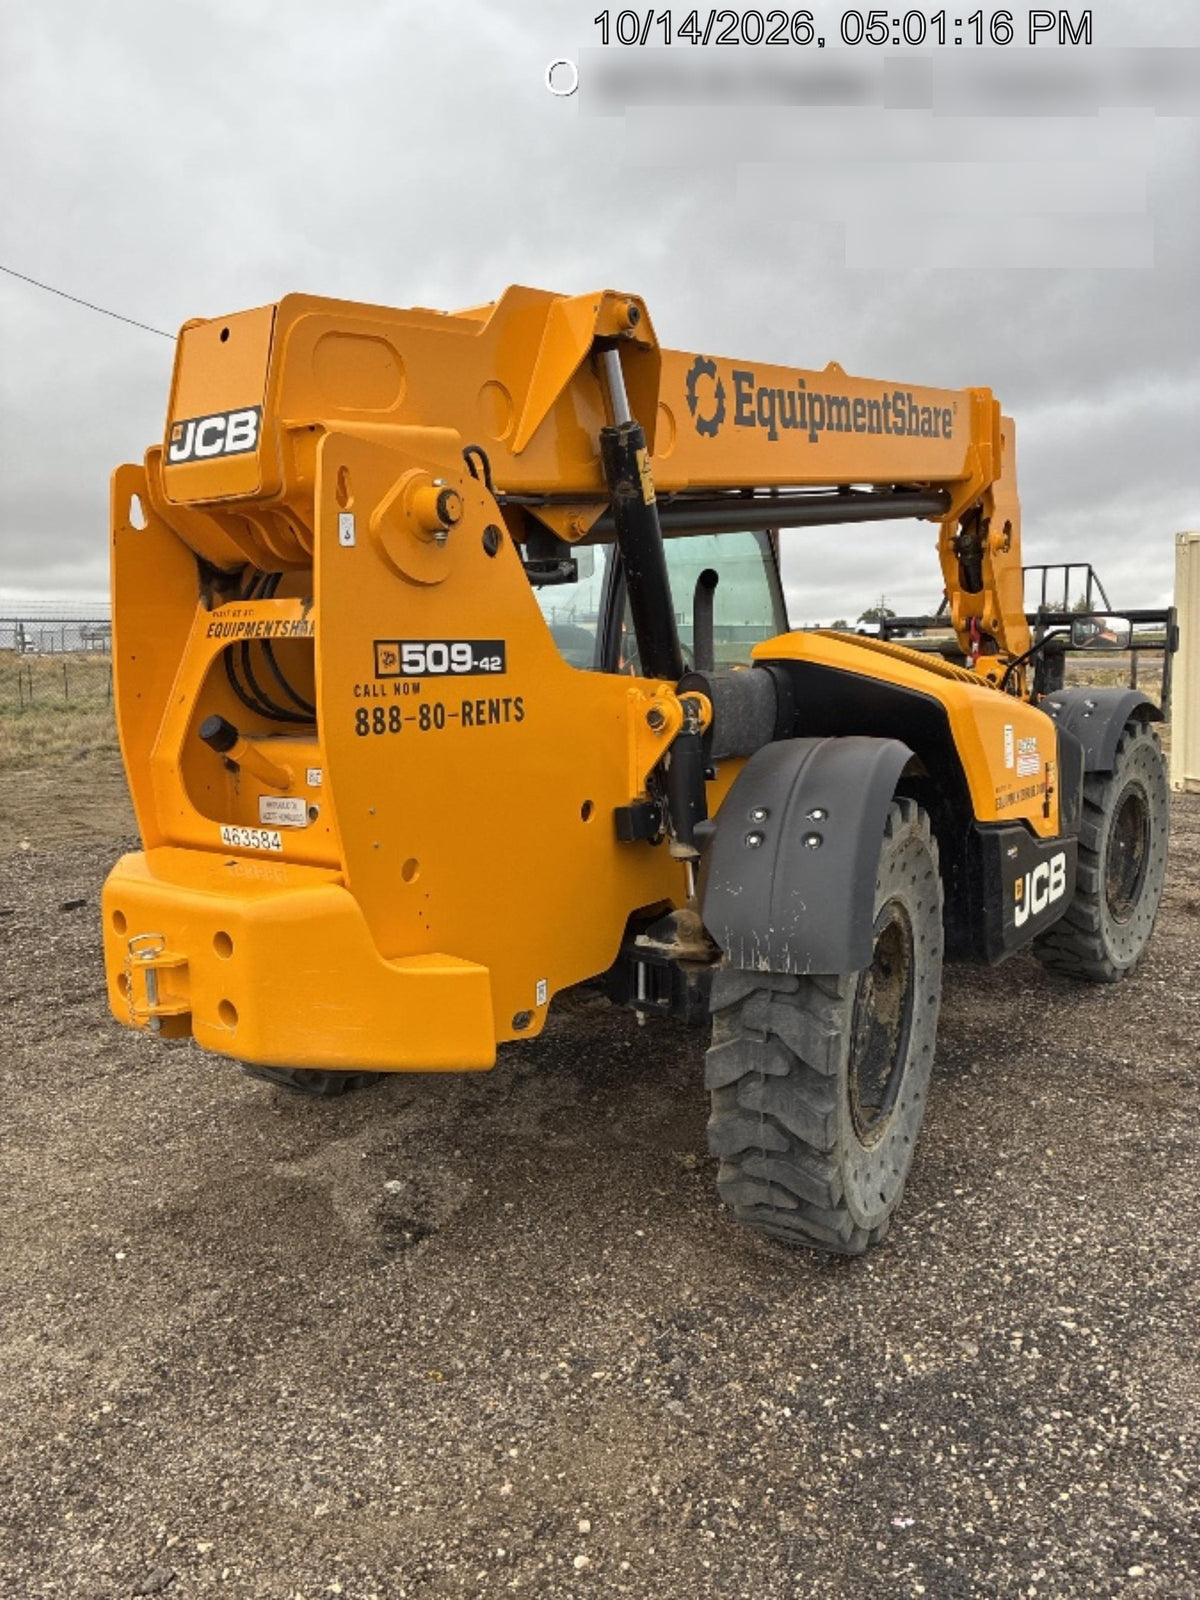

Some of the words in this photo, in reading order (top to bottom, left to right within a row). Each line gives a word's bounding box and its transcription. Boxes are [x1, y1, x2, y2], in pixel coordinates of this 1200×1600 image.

[732, 370, 953, 443] EquipmentShare
[169, 410, 258, 462] JCB
[354, 684, 387, 698] CALL
[394, 682, 421, 696] NOW
[355, 696, 525, 737] 888-80-RENTS
[223, 827, 282, 849] 463584
[1014, 852, 1066, 928] JCB
